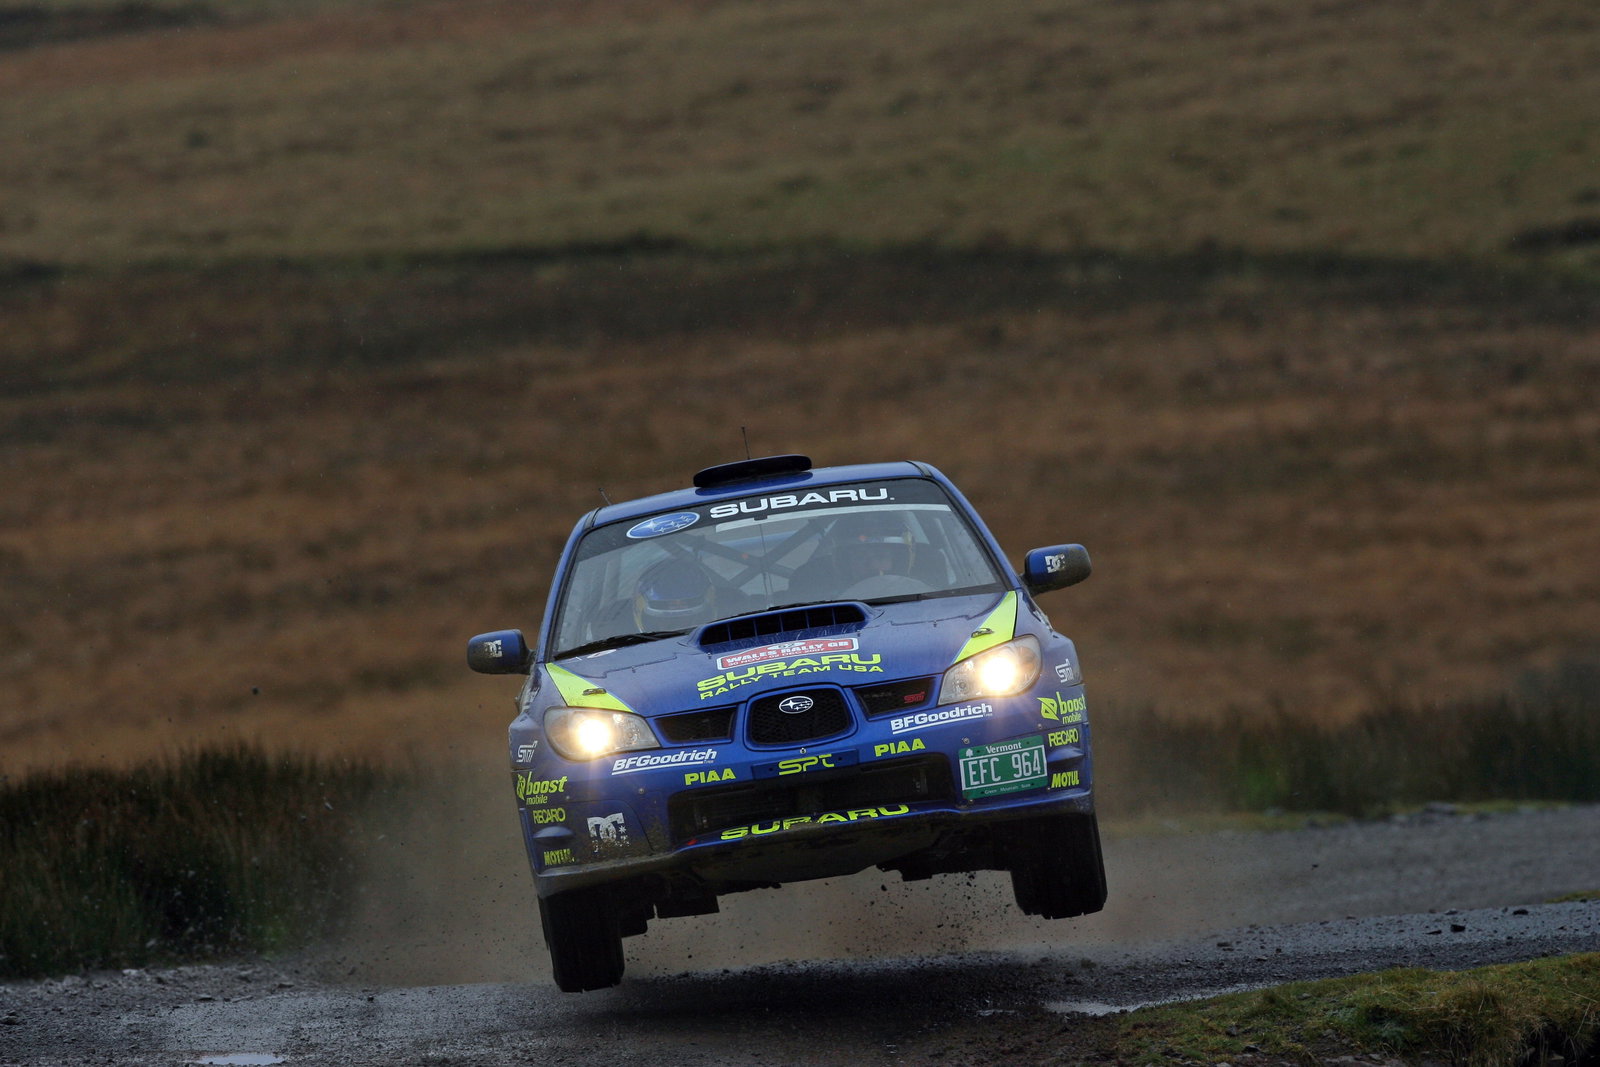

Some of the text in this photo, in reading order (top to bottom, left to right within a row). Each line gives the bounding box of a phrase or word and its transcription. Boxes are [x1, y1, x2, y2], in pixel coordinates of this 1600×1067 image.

[709, 488, 888, 519] SUBARU
[726, 651, 777, 663] WALES
[697, 653, 882, 692] SUBARU
[700, 664, 884, 700] RALLY TEAM USA
[1056, 691, 1086, 715] boost
[890, 703, 993, 731] BFGoodrich
[1062, 712, 1083, 725] mobile
[874, 738, 926, 757] PIAA
[985, 741, 1022, 754] Vermont
[1048, 728, 1079, 748] RECARO
[612, 748, 718, 773] BFGoodrich
[968, 749, 1042, 786] EFC 964
[526, 771, 568, 795] boost
[684, 768, 737, 786] PIAA
[1051, 770, 1080, 789] MOTUL
[526, 795, 549, 806] mobile
[532, 807, 567, 825] RECARO
